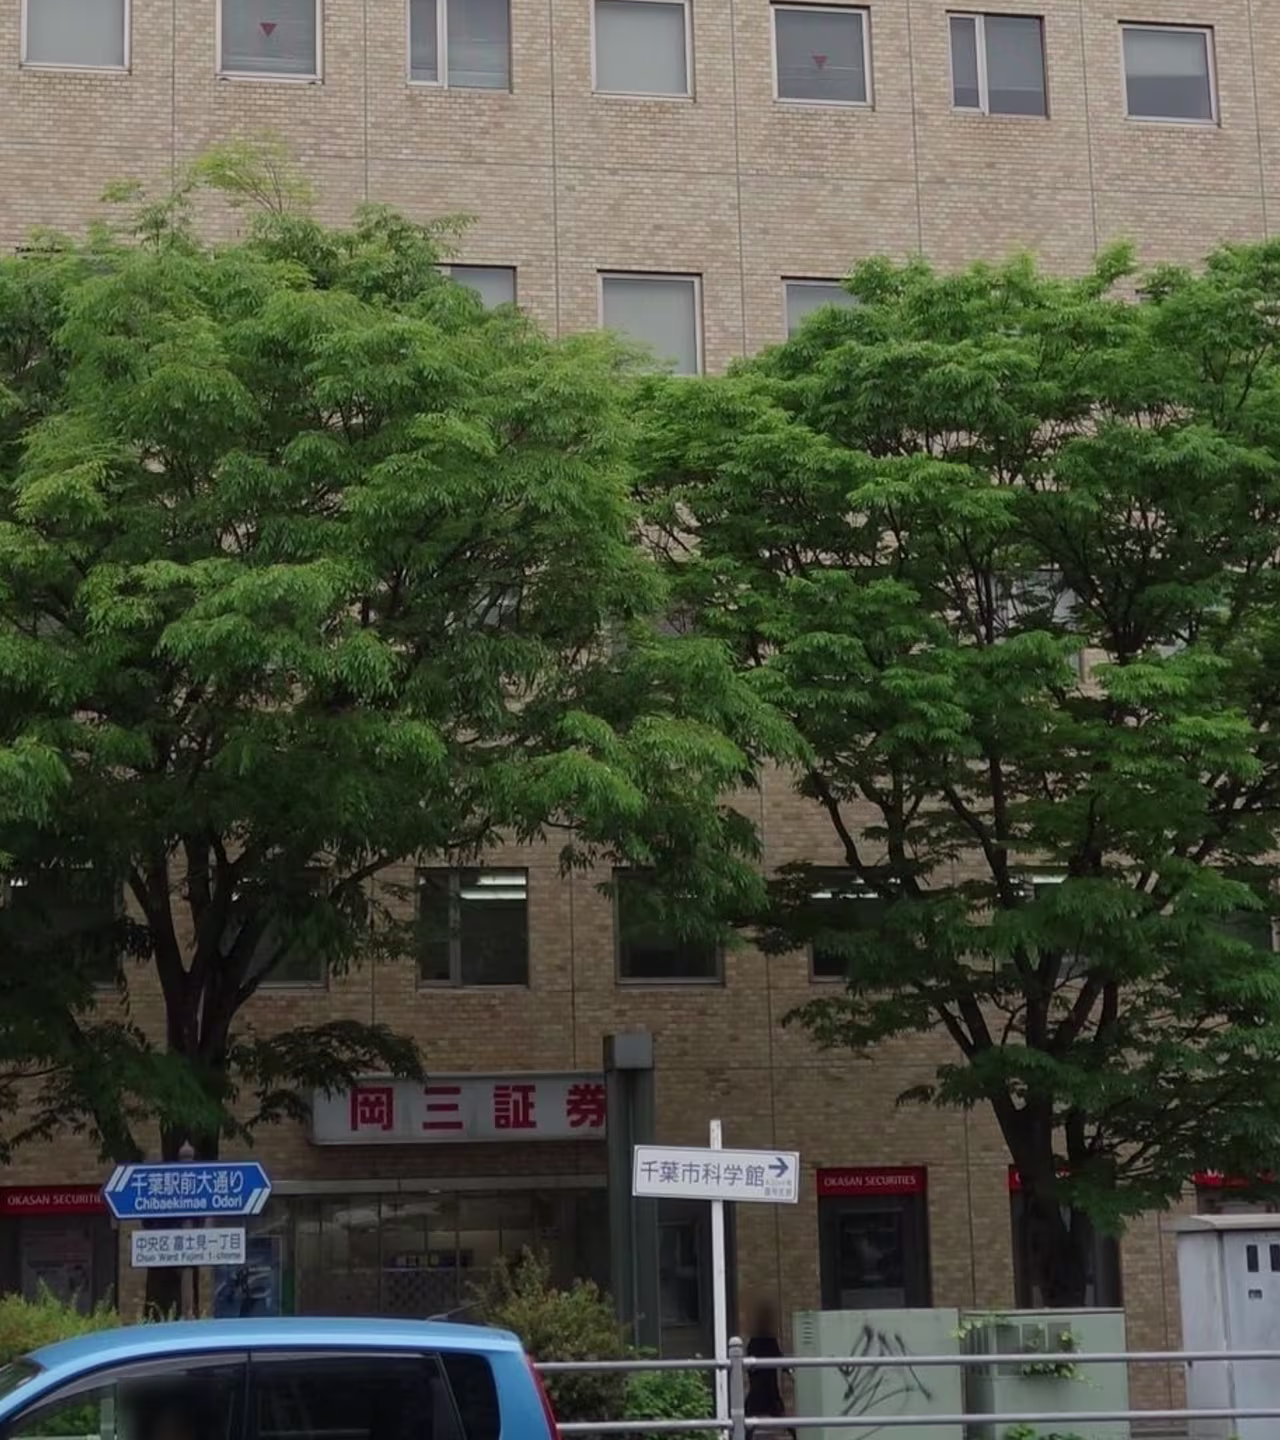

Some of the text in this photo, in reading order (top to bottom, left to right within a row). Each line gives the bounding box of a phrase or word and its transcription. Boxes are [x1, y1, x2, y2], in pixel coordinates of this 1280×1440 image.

[350, 1084, 606, 1131] 岡三証券
[131, 1170, 244, 1196] 千葉駅前大通り
[640, 1160, 765, 1188] 千葉市科学館
[823, 1175, 916, 1187] OKASAN SECURITIES
[7, 1193, 102, 1206] OKASAN SECURITI
[134, 1195, 242, 1211] Chibaekimae Odori
[136, 1233, 241, 1252] 中央区 富士見一丁目
